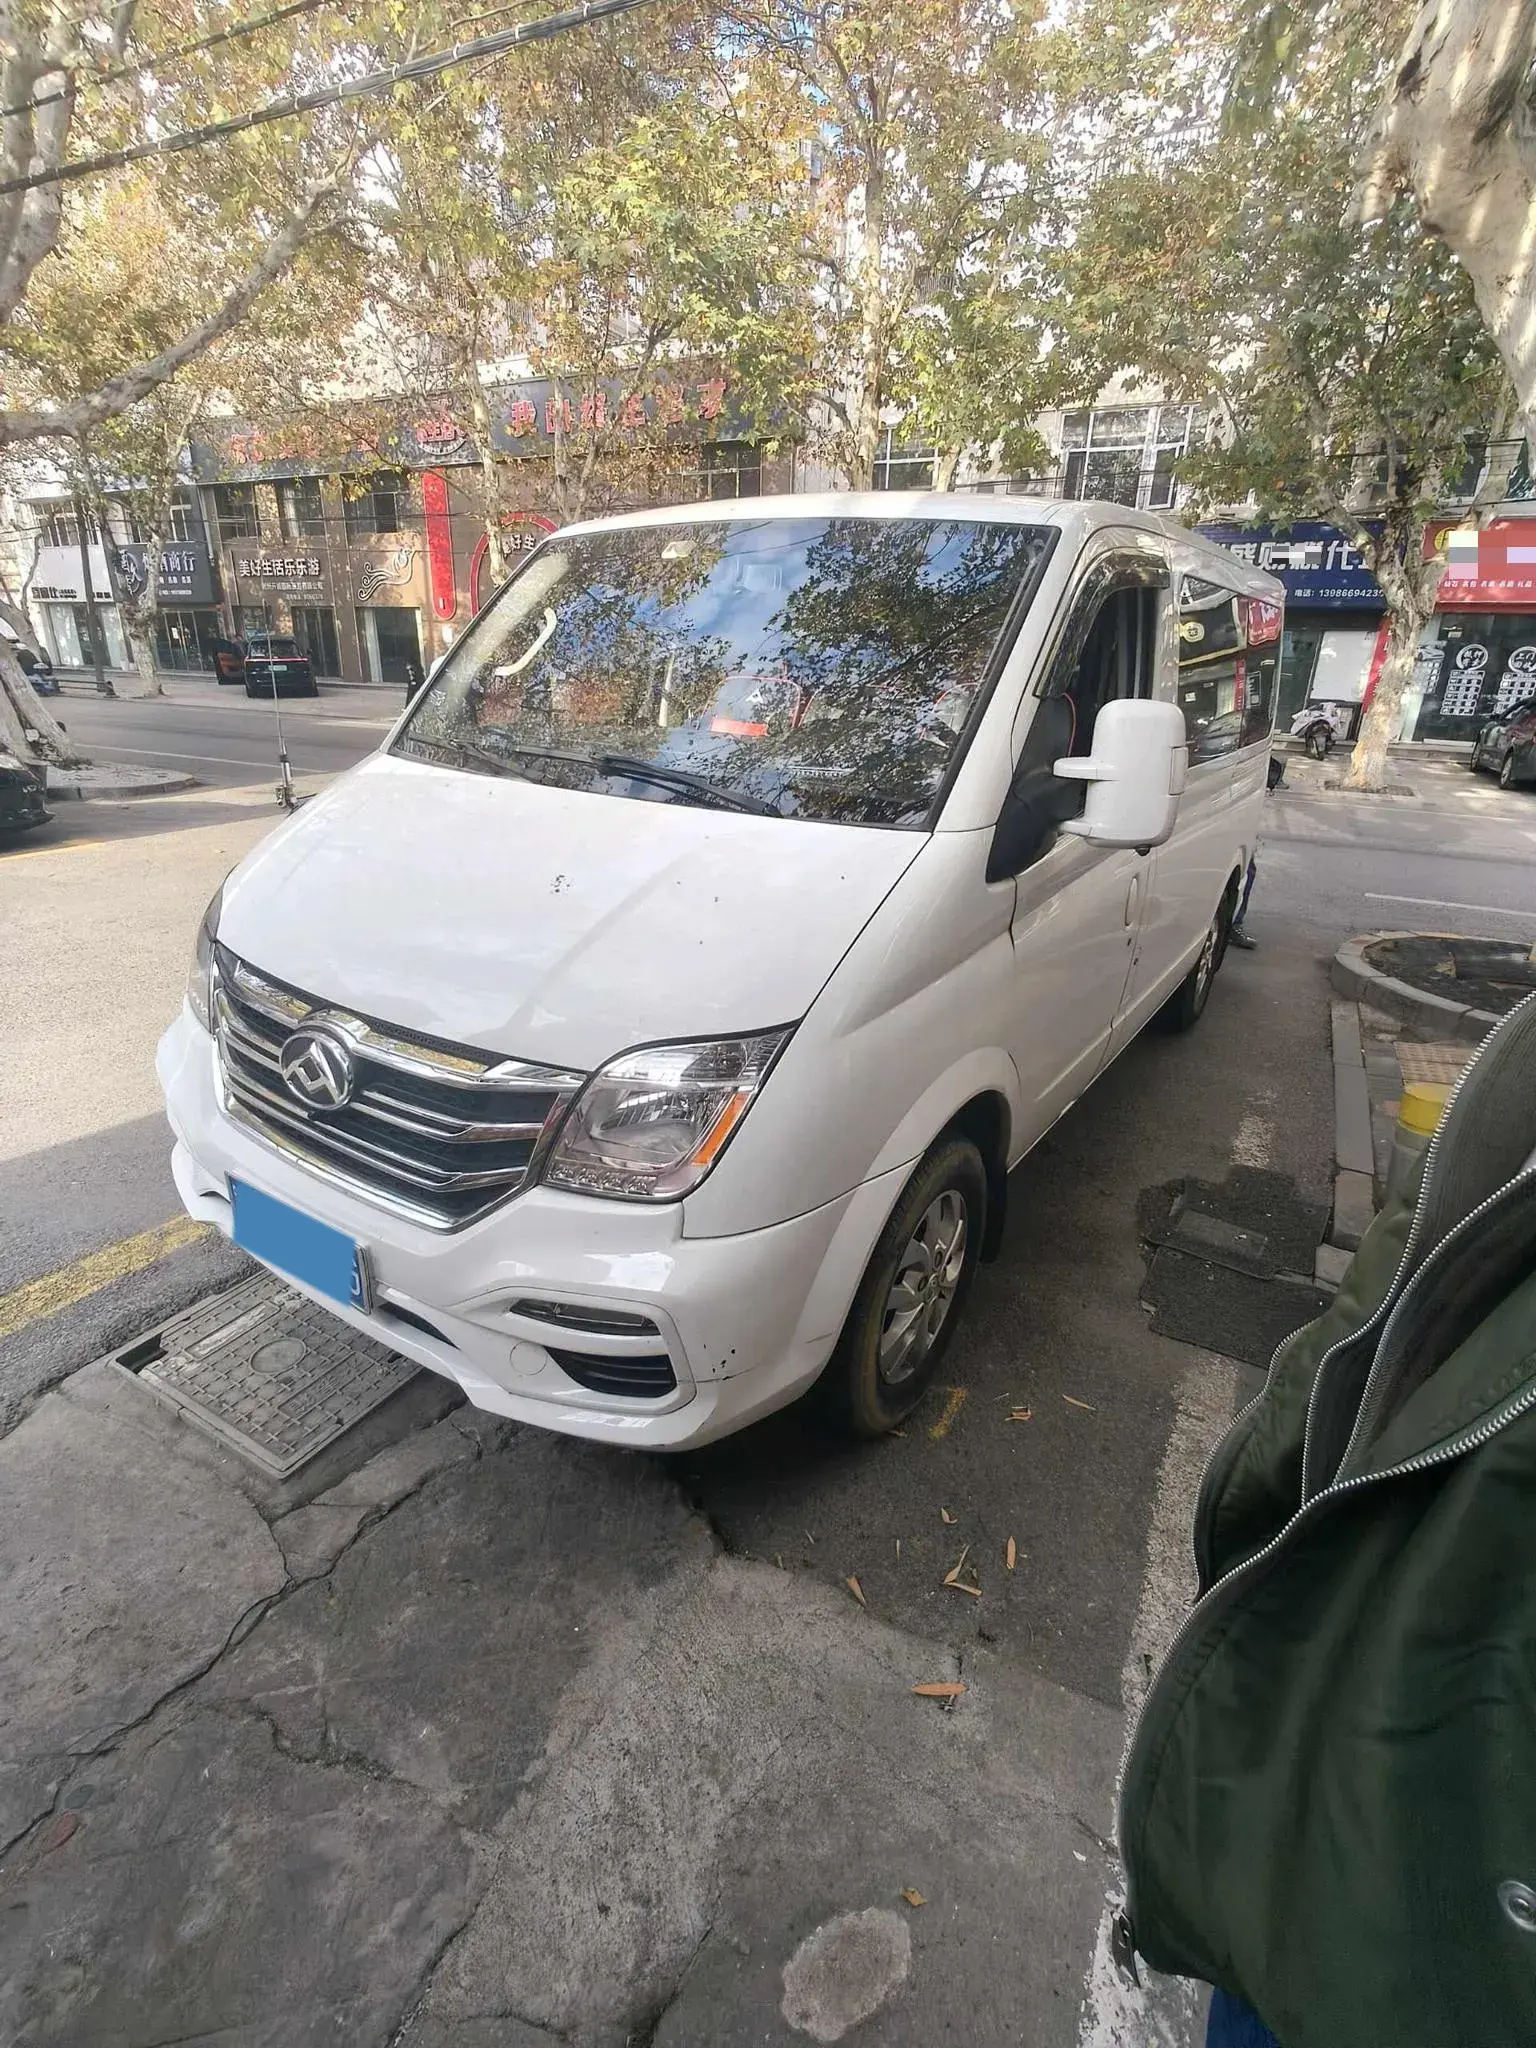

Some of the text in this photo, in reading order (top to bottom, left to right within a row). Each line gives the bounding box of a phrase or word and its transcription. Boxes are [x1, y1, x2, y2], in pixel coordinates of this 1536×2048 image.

[239, 558, 320, 577] 美好生活乐乐游
